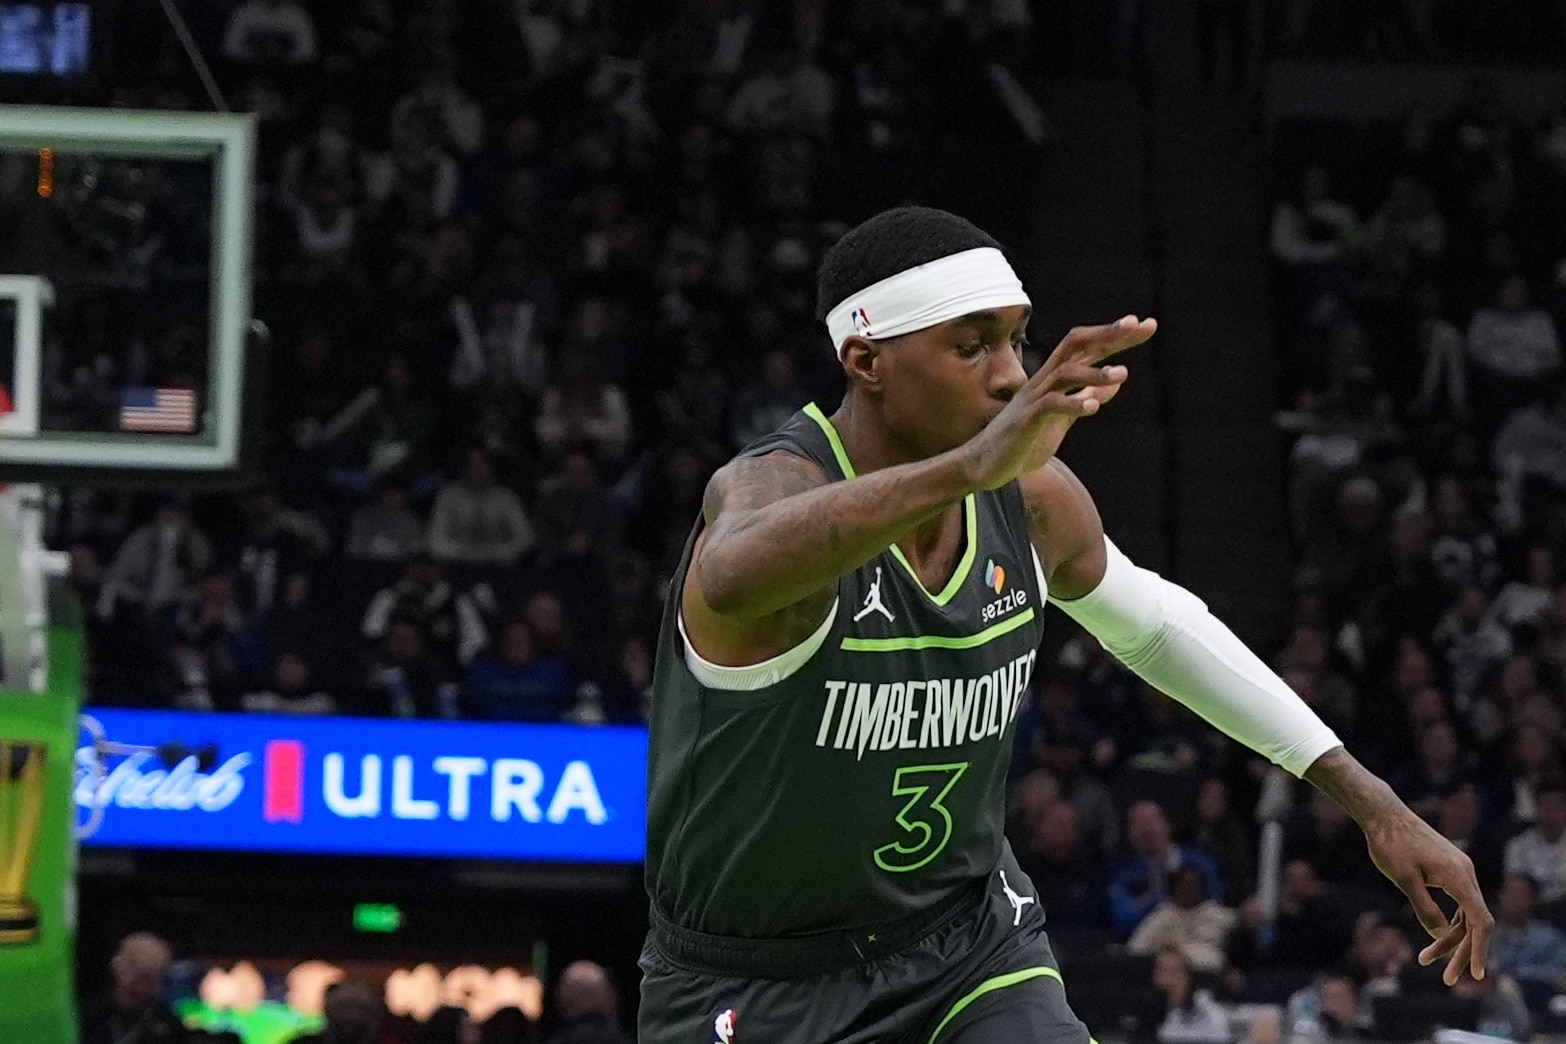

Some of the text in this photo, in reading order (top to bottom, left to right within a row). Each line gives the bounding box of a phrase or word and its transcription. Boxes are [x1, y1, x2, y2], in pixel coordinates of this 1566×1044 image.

[981, 588, 1028, 623] sezzle
[322, 752, 608, 825] ULTRA
[873, 762, 970, 873] 3
